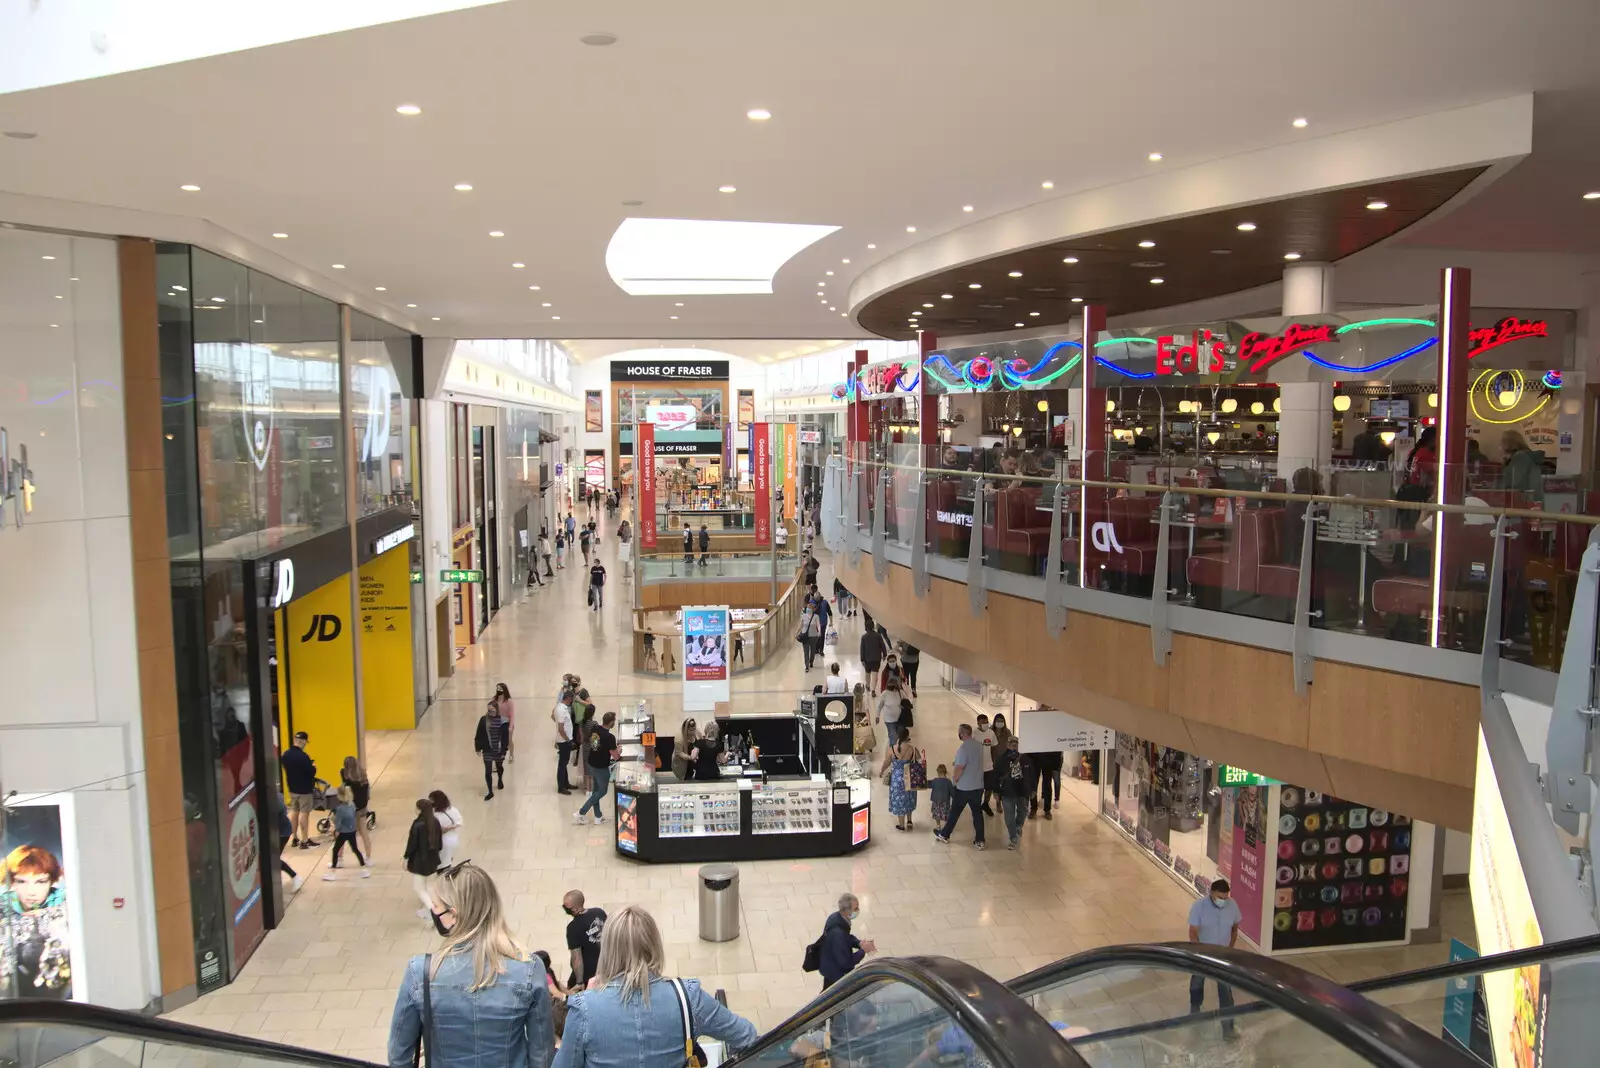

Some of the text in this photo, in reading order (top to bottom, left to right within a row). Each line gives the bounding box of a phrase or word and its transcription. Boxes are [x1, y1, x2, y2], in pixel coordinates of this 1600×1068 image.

[627, 366, 713, 375] HOUSE OF FRASER
[275, 558, 294, 608] JD
[301, 614, 342, 643] JD
[1226, 773, 1248, 783] EXIT
